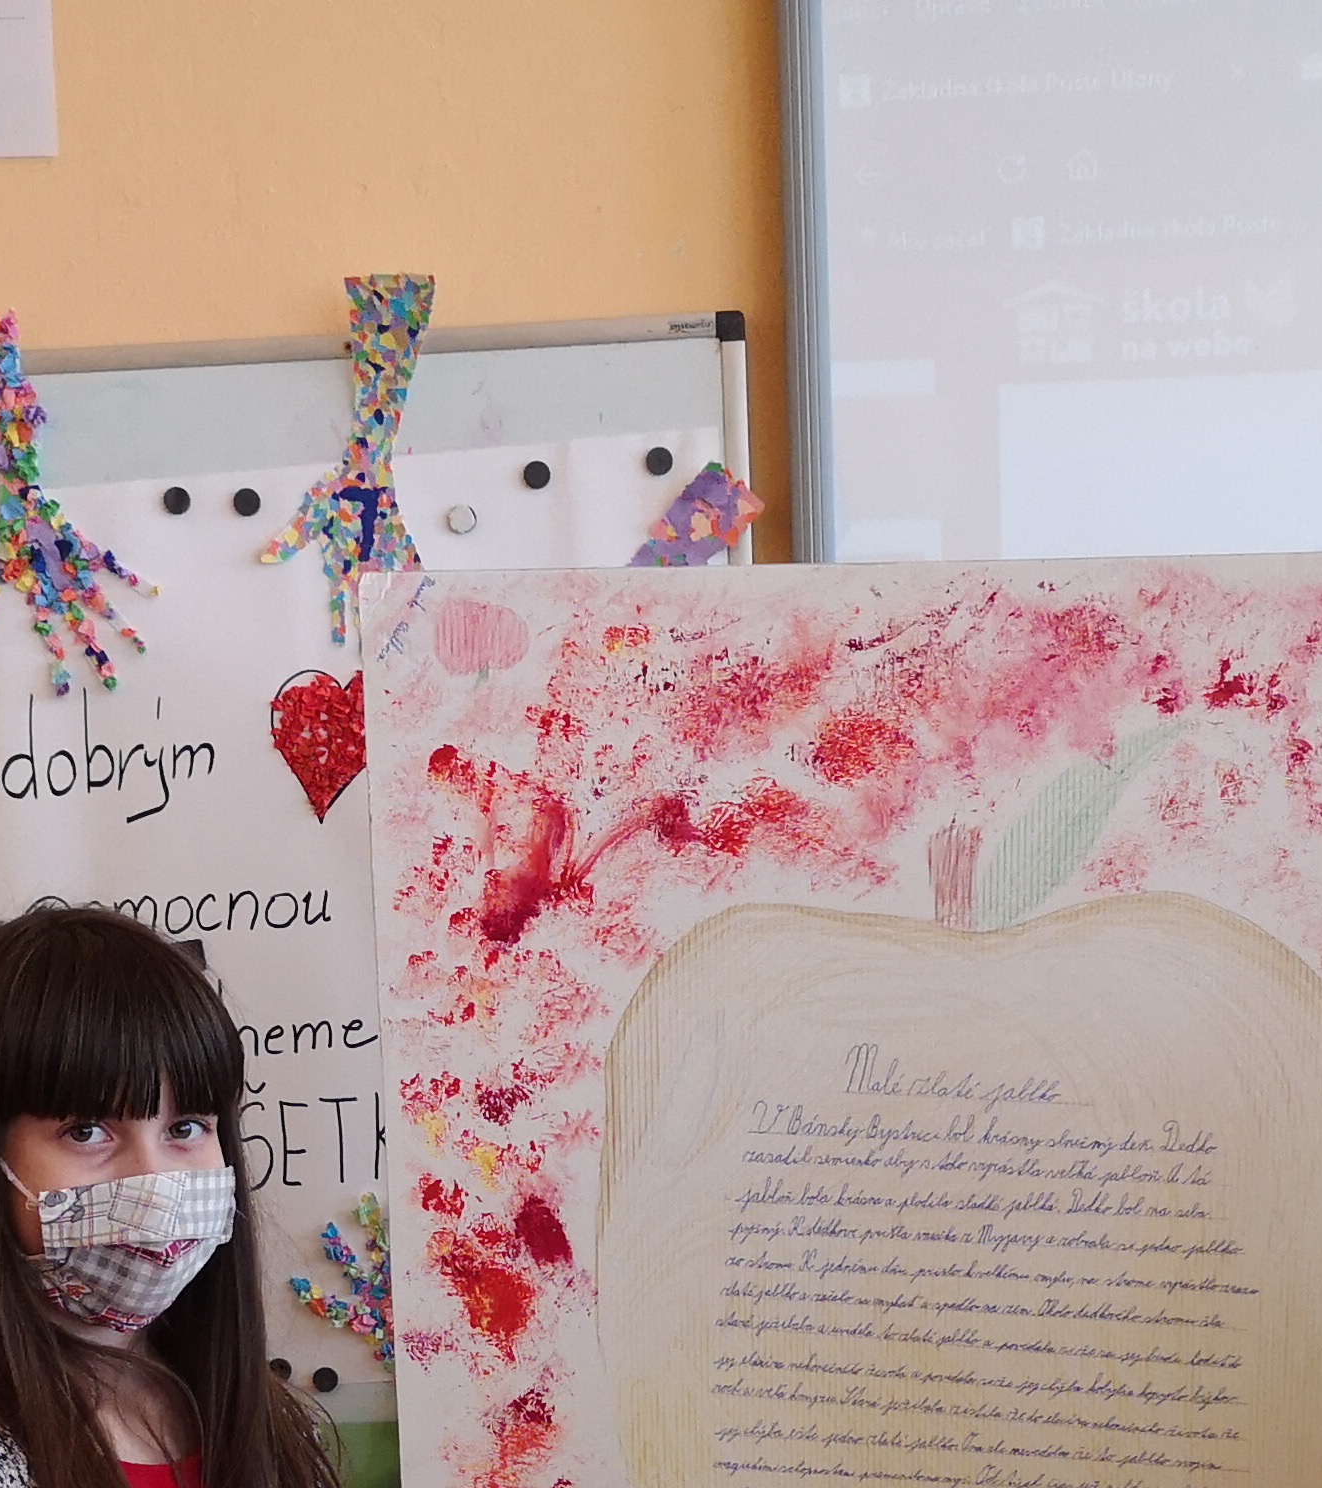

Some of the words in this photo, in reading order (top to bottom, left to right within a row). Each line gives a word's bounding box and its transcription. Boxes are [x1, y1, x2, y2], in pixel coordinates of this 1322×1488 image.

[1119, 287, 1232, 325] škola
[1120, 337, 1158, 362] na
[1164, 334, 1254, 361] webe
[1, 687, 216, 824] dobrým
[27, 889, 332, 935] mocnou
[843, 1042, 902, 1094] Malé
[906, 1070, 981, 1100] zlaté
[978, 1077, 1062, 1114] jablko
[943, 1114, 975, 1144] bol
[1159, 1119, 1218, 1155] Dedko
[741, 1145, 812, 1167] zasadil
[812, 1149, 880, 1168] semienko
[883, 1149, 919, 1179] aby
[797, 1182, 832, 1205] bola
[895, 1187, 952, 1216] plodila
[1066, 1187, 1113, 1217] Dedko
[1113, 1197, 1142, 1218] bol
[1147, 1204, 1172, 1218] na
